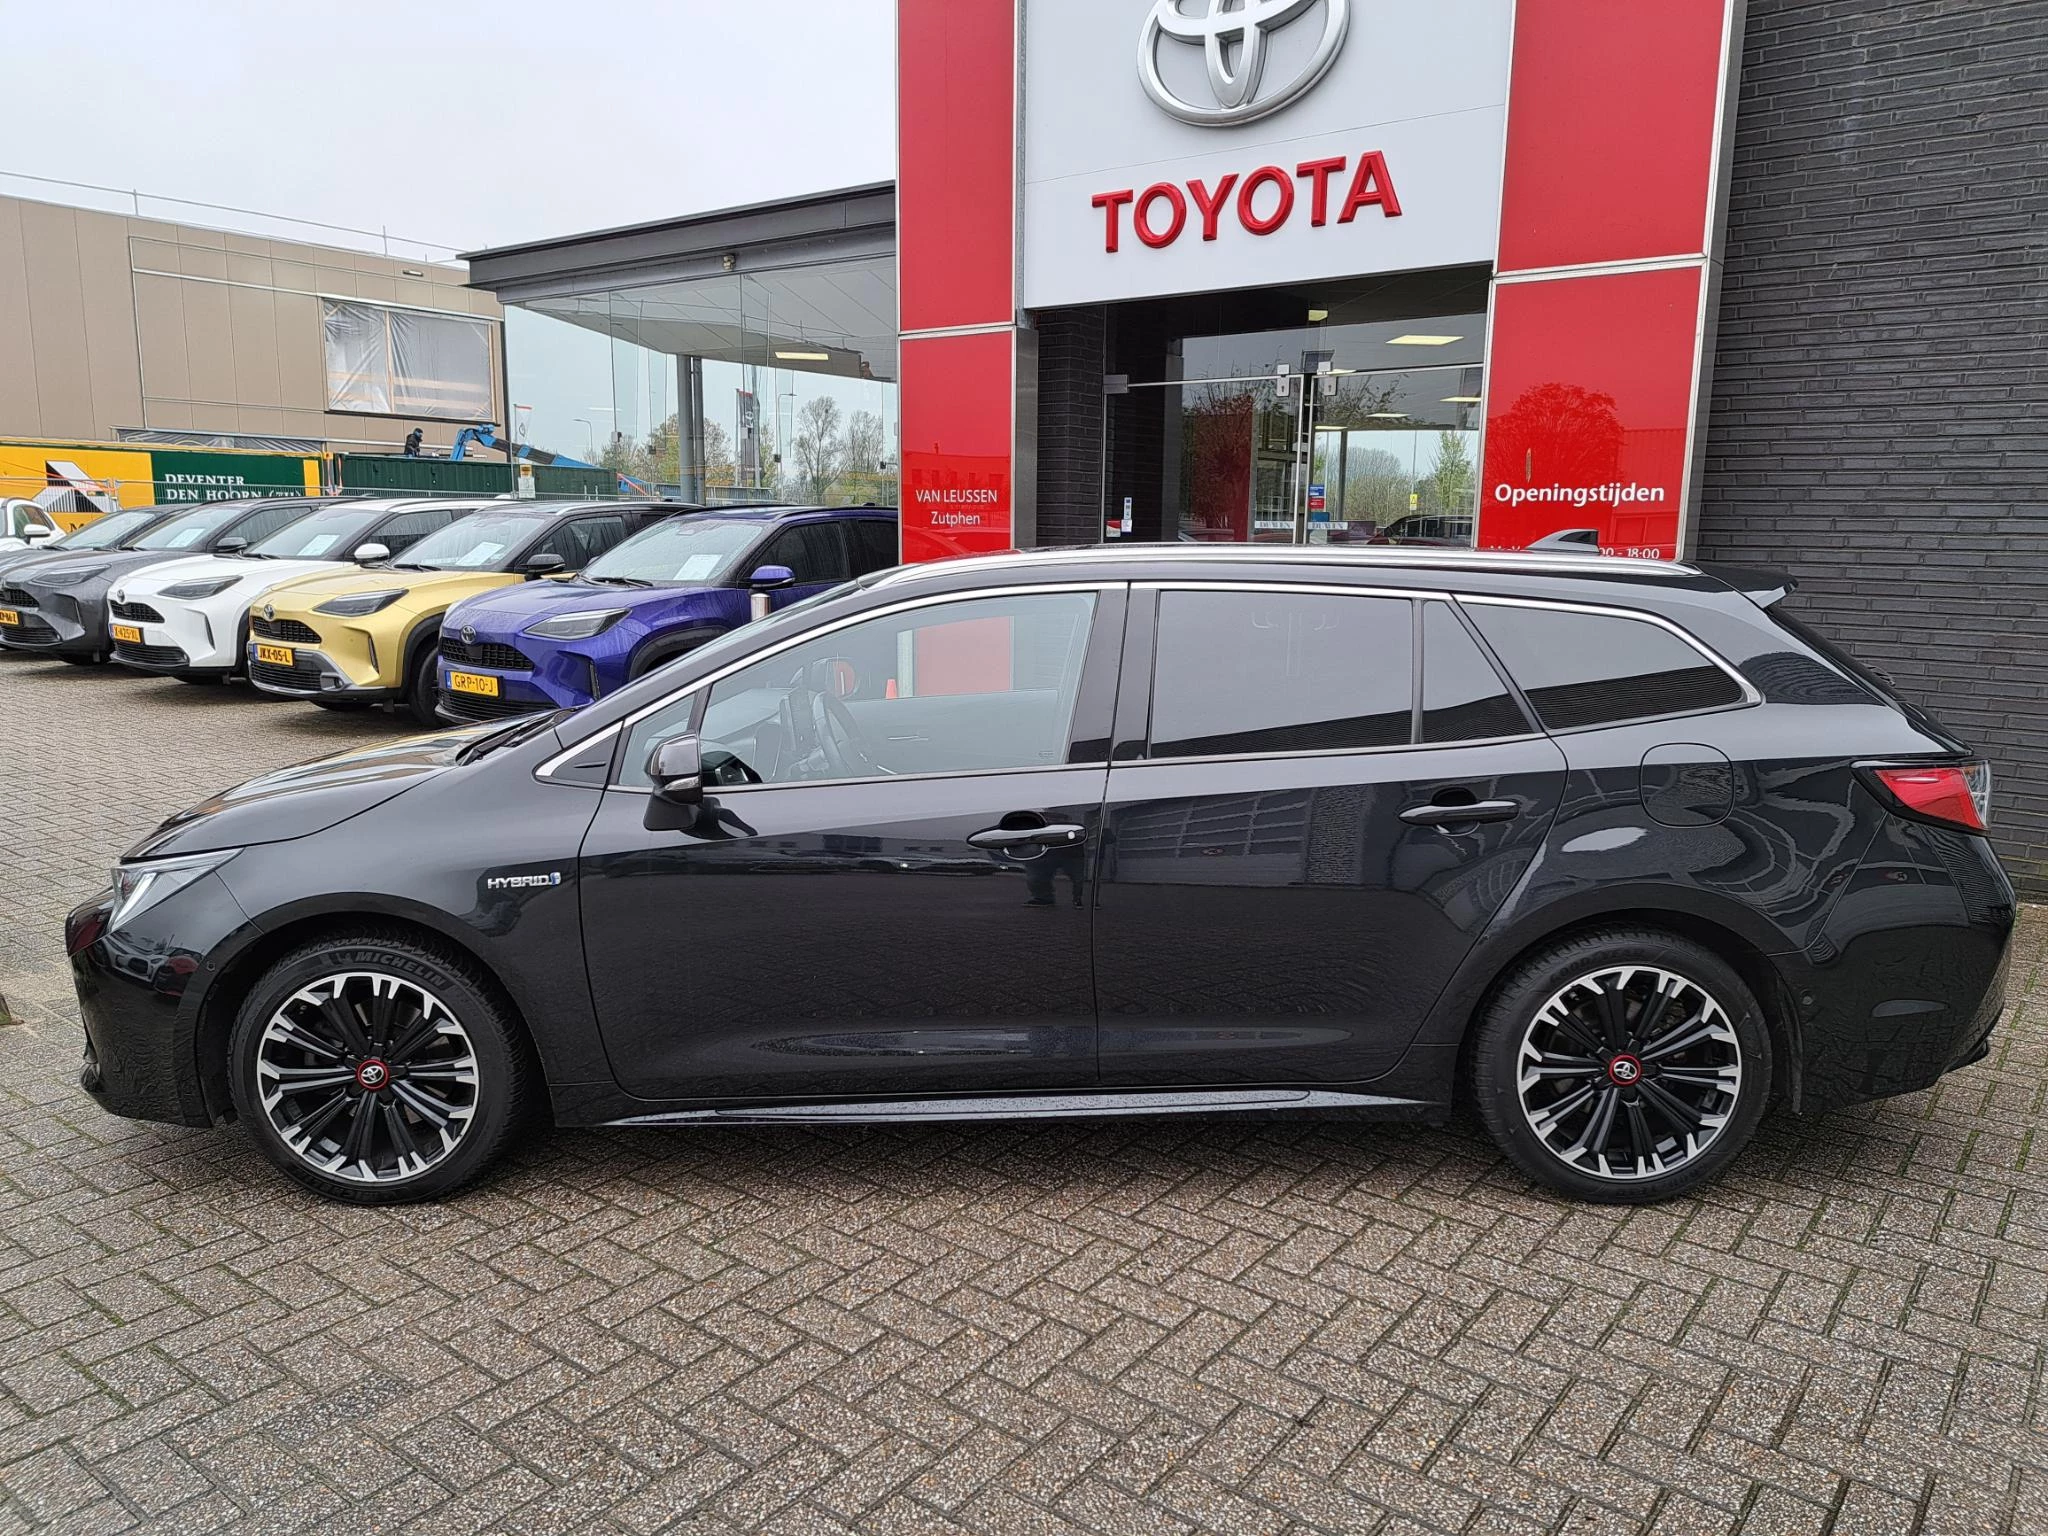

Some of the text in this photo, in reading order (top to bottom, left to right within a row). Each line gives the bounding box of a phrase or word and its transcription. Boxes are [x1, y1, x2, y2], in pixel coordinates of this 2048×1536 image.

[1092, 150, 1402, 253] TOYOTA
[165, 474, 244, 485] DEVENTER
[167, 489, 199, 500] DEN
[916, 489, 998, 503] VAN LEUSSEN
[1495, 483, 1665, 507] Openingstijden
[931, 511, 981, 527] Zutphen
[1627, 548, 1660, 559] 18:00
[260, 647, 290, 663] JKX-05-L
[454, 674, 494, 692] GRP-10-J
[487, 874, 549, 889] HYBRID
[354, 951, 447, 987] MICHELIN
